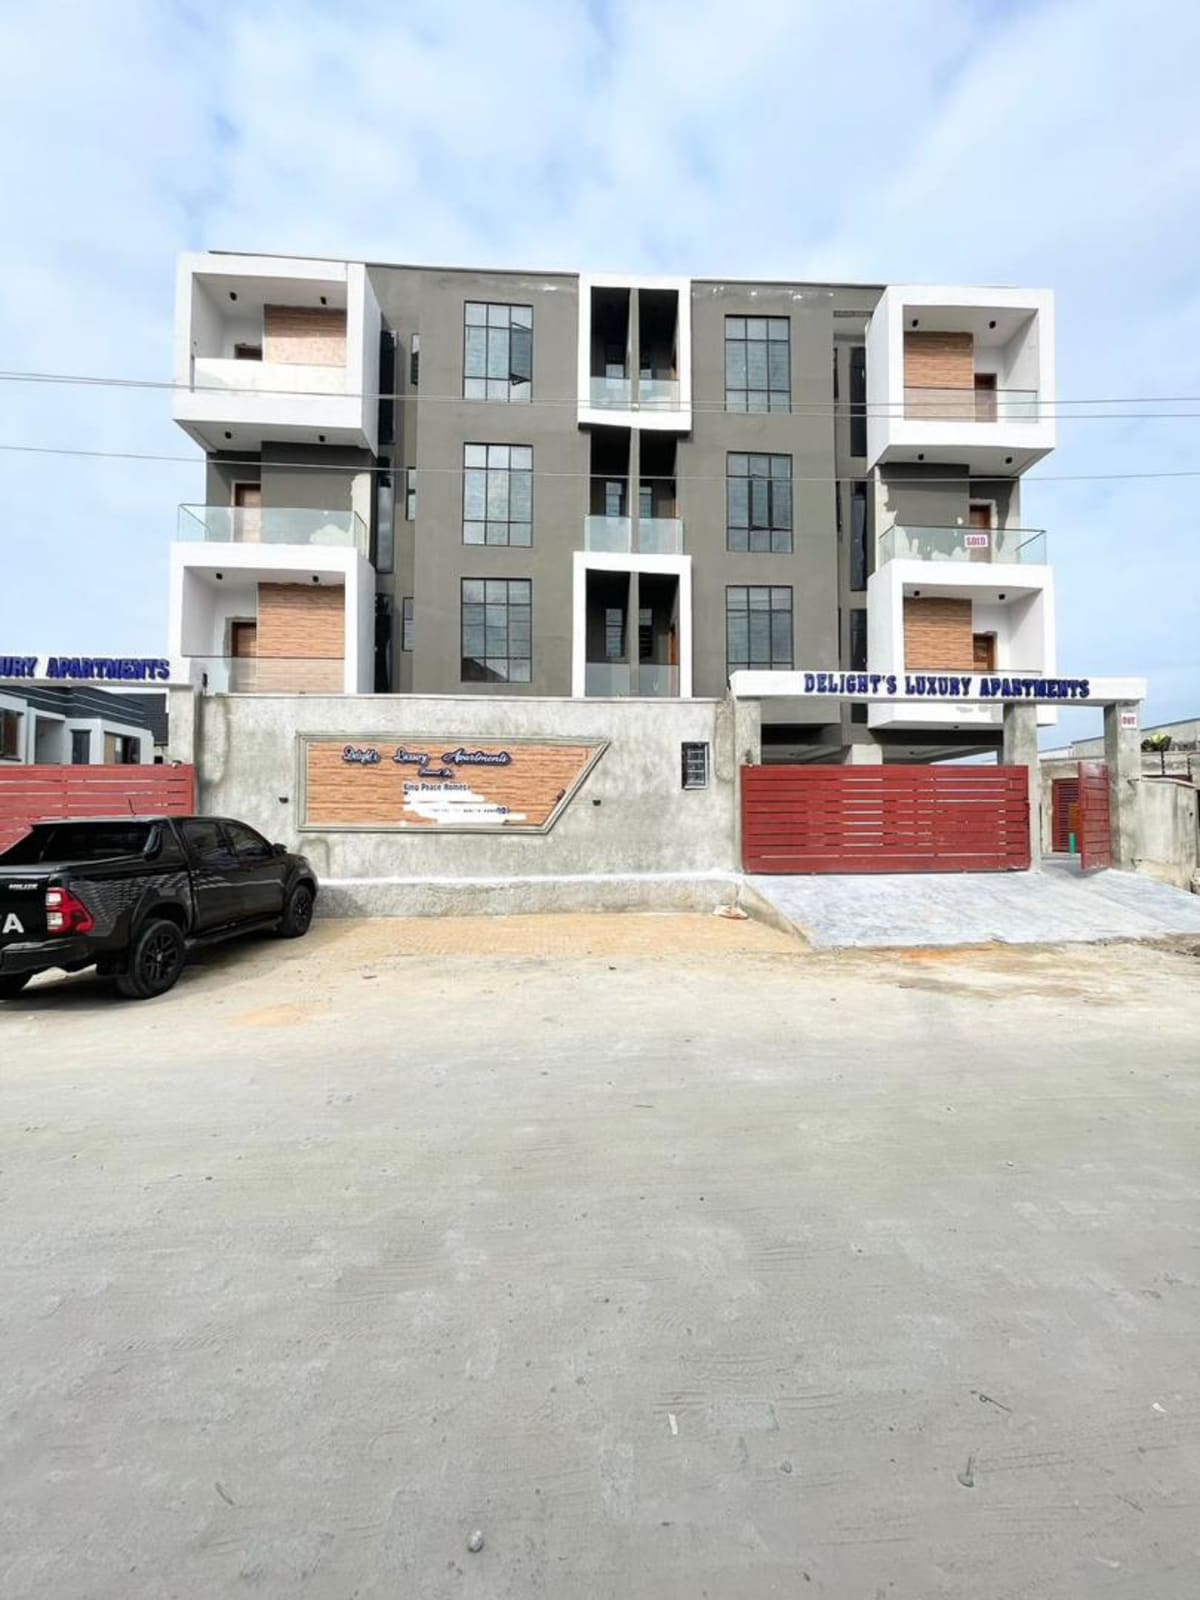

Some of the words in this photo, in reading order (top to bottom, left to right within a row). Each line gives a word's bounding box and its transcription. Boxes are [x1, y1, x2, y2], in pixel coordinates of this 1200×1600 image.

[46, 657, 170, 680] APARTMENTS
[804, 673, 897, 694] DELIGHT'S
[904, 675, 972, 697] LUXURY
[979, 678, 1091, 699] APARTMENTS
[2, 913, 24, 934] A
